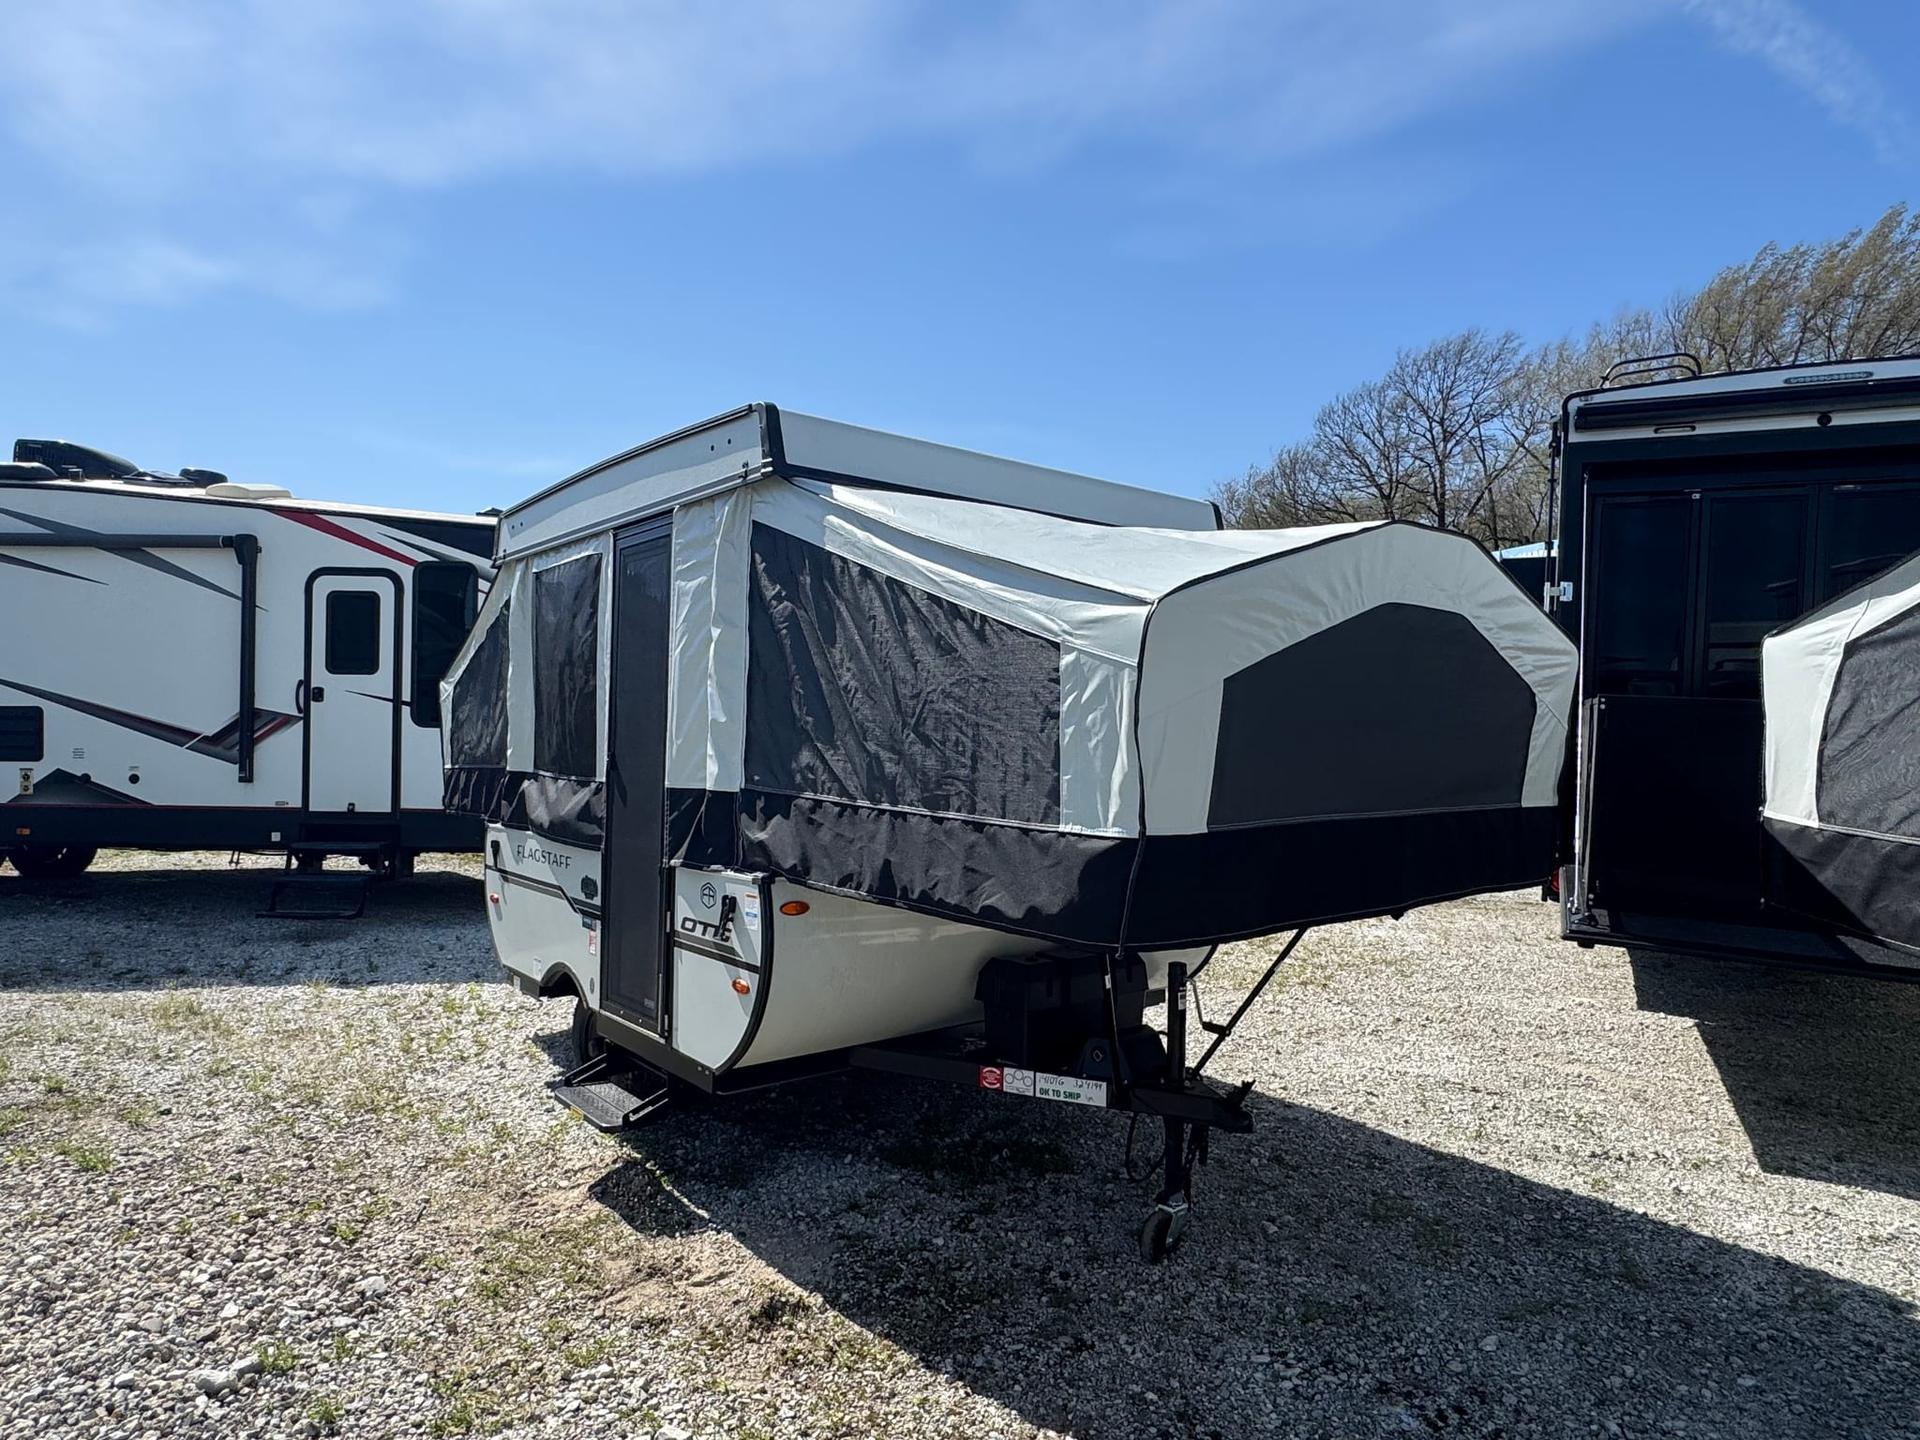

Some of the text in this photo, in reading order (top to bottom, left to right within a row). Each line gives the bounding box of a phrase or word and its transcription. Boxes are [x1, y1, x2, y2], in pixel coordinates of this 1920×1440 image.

[517, 844, 572, 869] FLAGSTAFF
[1039, 1087, 1050, 1096] OK
[1052, 1089, 1061, 1098] TO
[1063, 1090, 1081, 1100] SHIP
